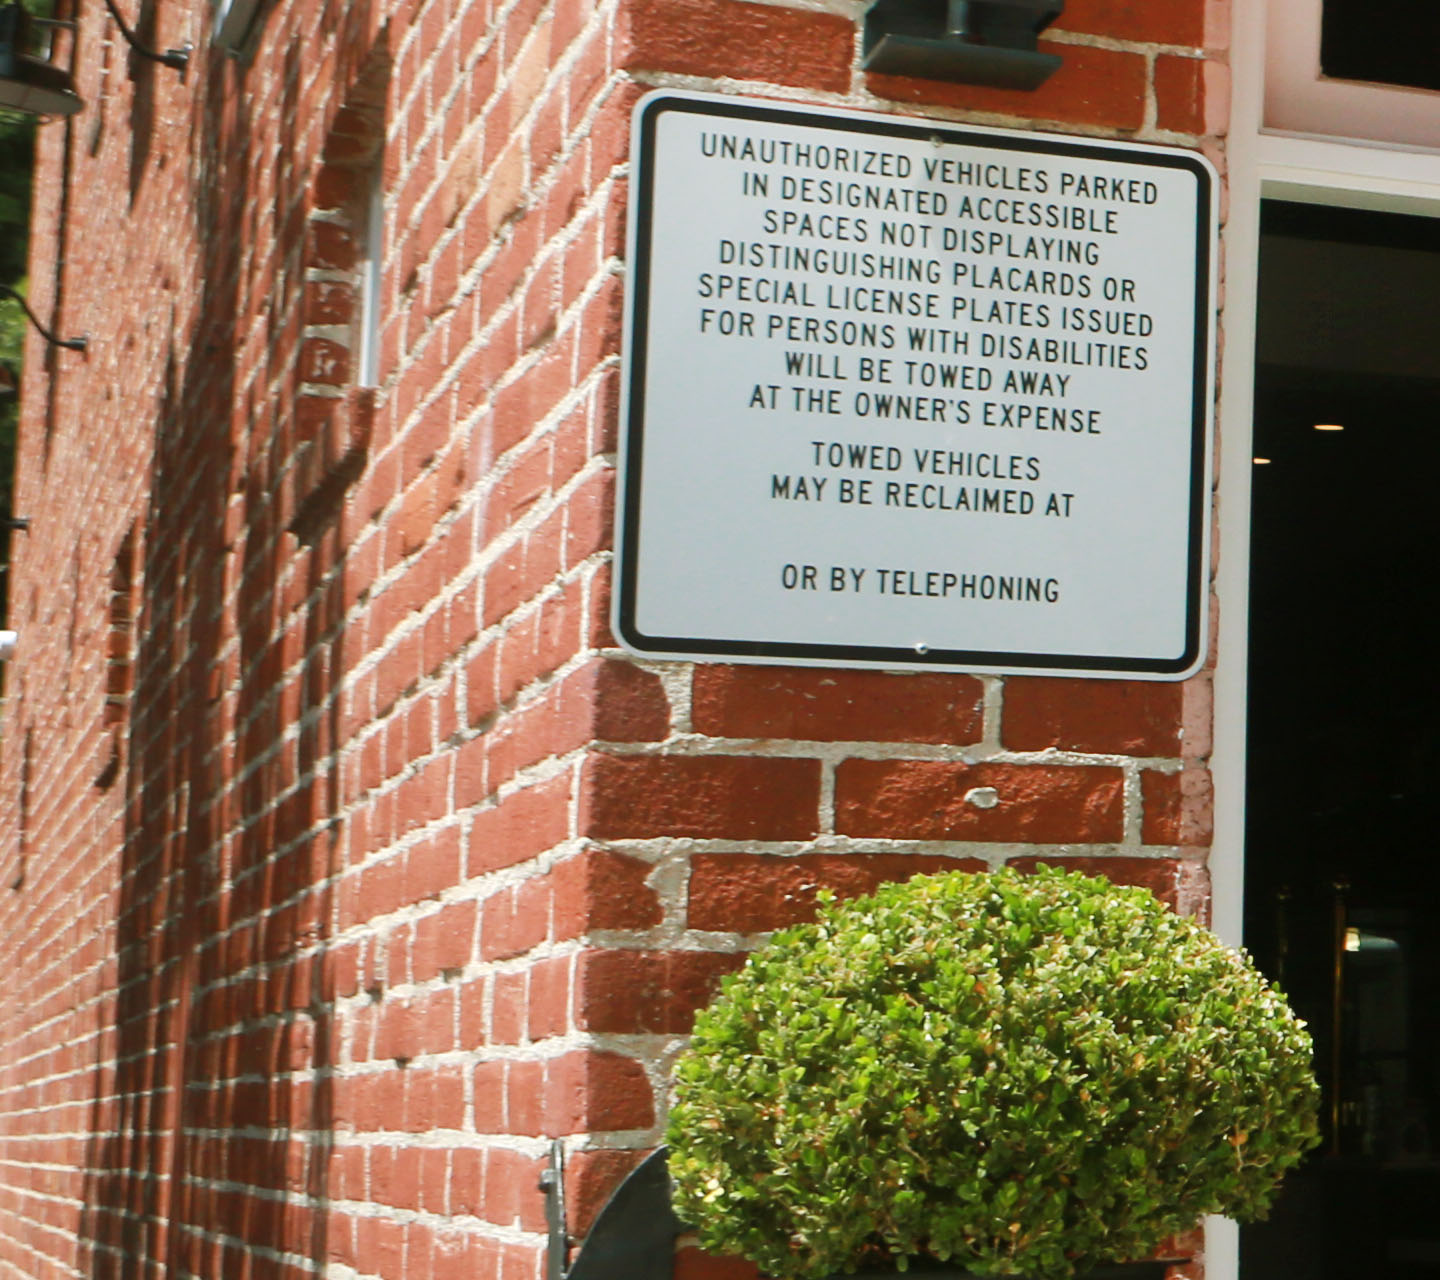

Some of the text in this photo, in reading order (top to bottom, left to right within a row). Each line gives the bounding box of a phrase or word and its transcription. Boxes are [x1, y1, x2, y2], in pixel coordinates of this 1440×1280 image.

[702, 133, 1158, 205] UNAUTHORIZED VEHICLES PARKED
[744, 172, 1118, 234] IN DESIGNATED ACCESSIBLE
[764, 209, 1099, 266] SPACES NOT DISPLAYING
[720, 239, 1135, 303] DISTINGUISHING PLACARDS OR
[699, 273, 1153, 337] SPECIAL LICENSE PLATES ISSUED
[701, 308, 1148, 371] FOR PERSONS WITH DISABILITIES
[785, 351, 1070, 398] WILL BE TOWED AWAY
[749, 384, 1101, 435] AT THE OWNER'S EXPENSE
[811, 441, 1040, 481] TOWED VEHICLES
[772, 474, 1075, 518] MAY BE RECLAIMED AT
[782, 564, 1059, 603] OR BY TELEPHONING
